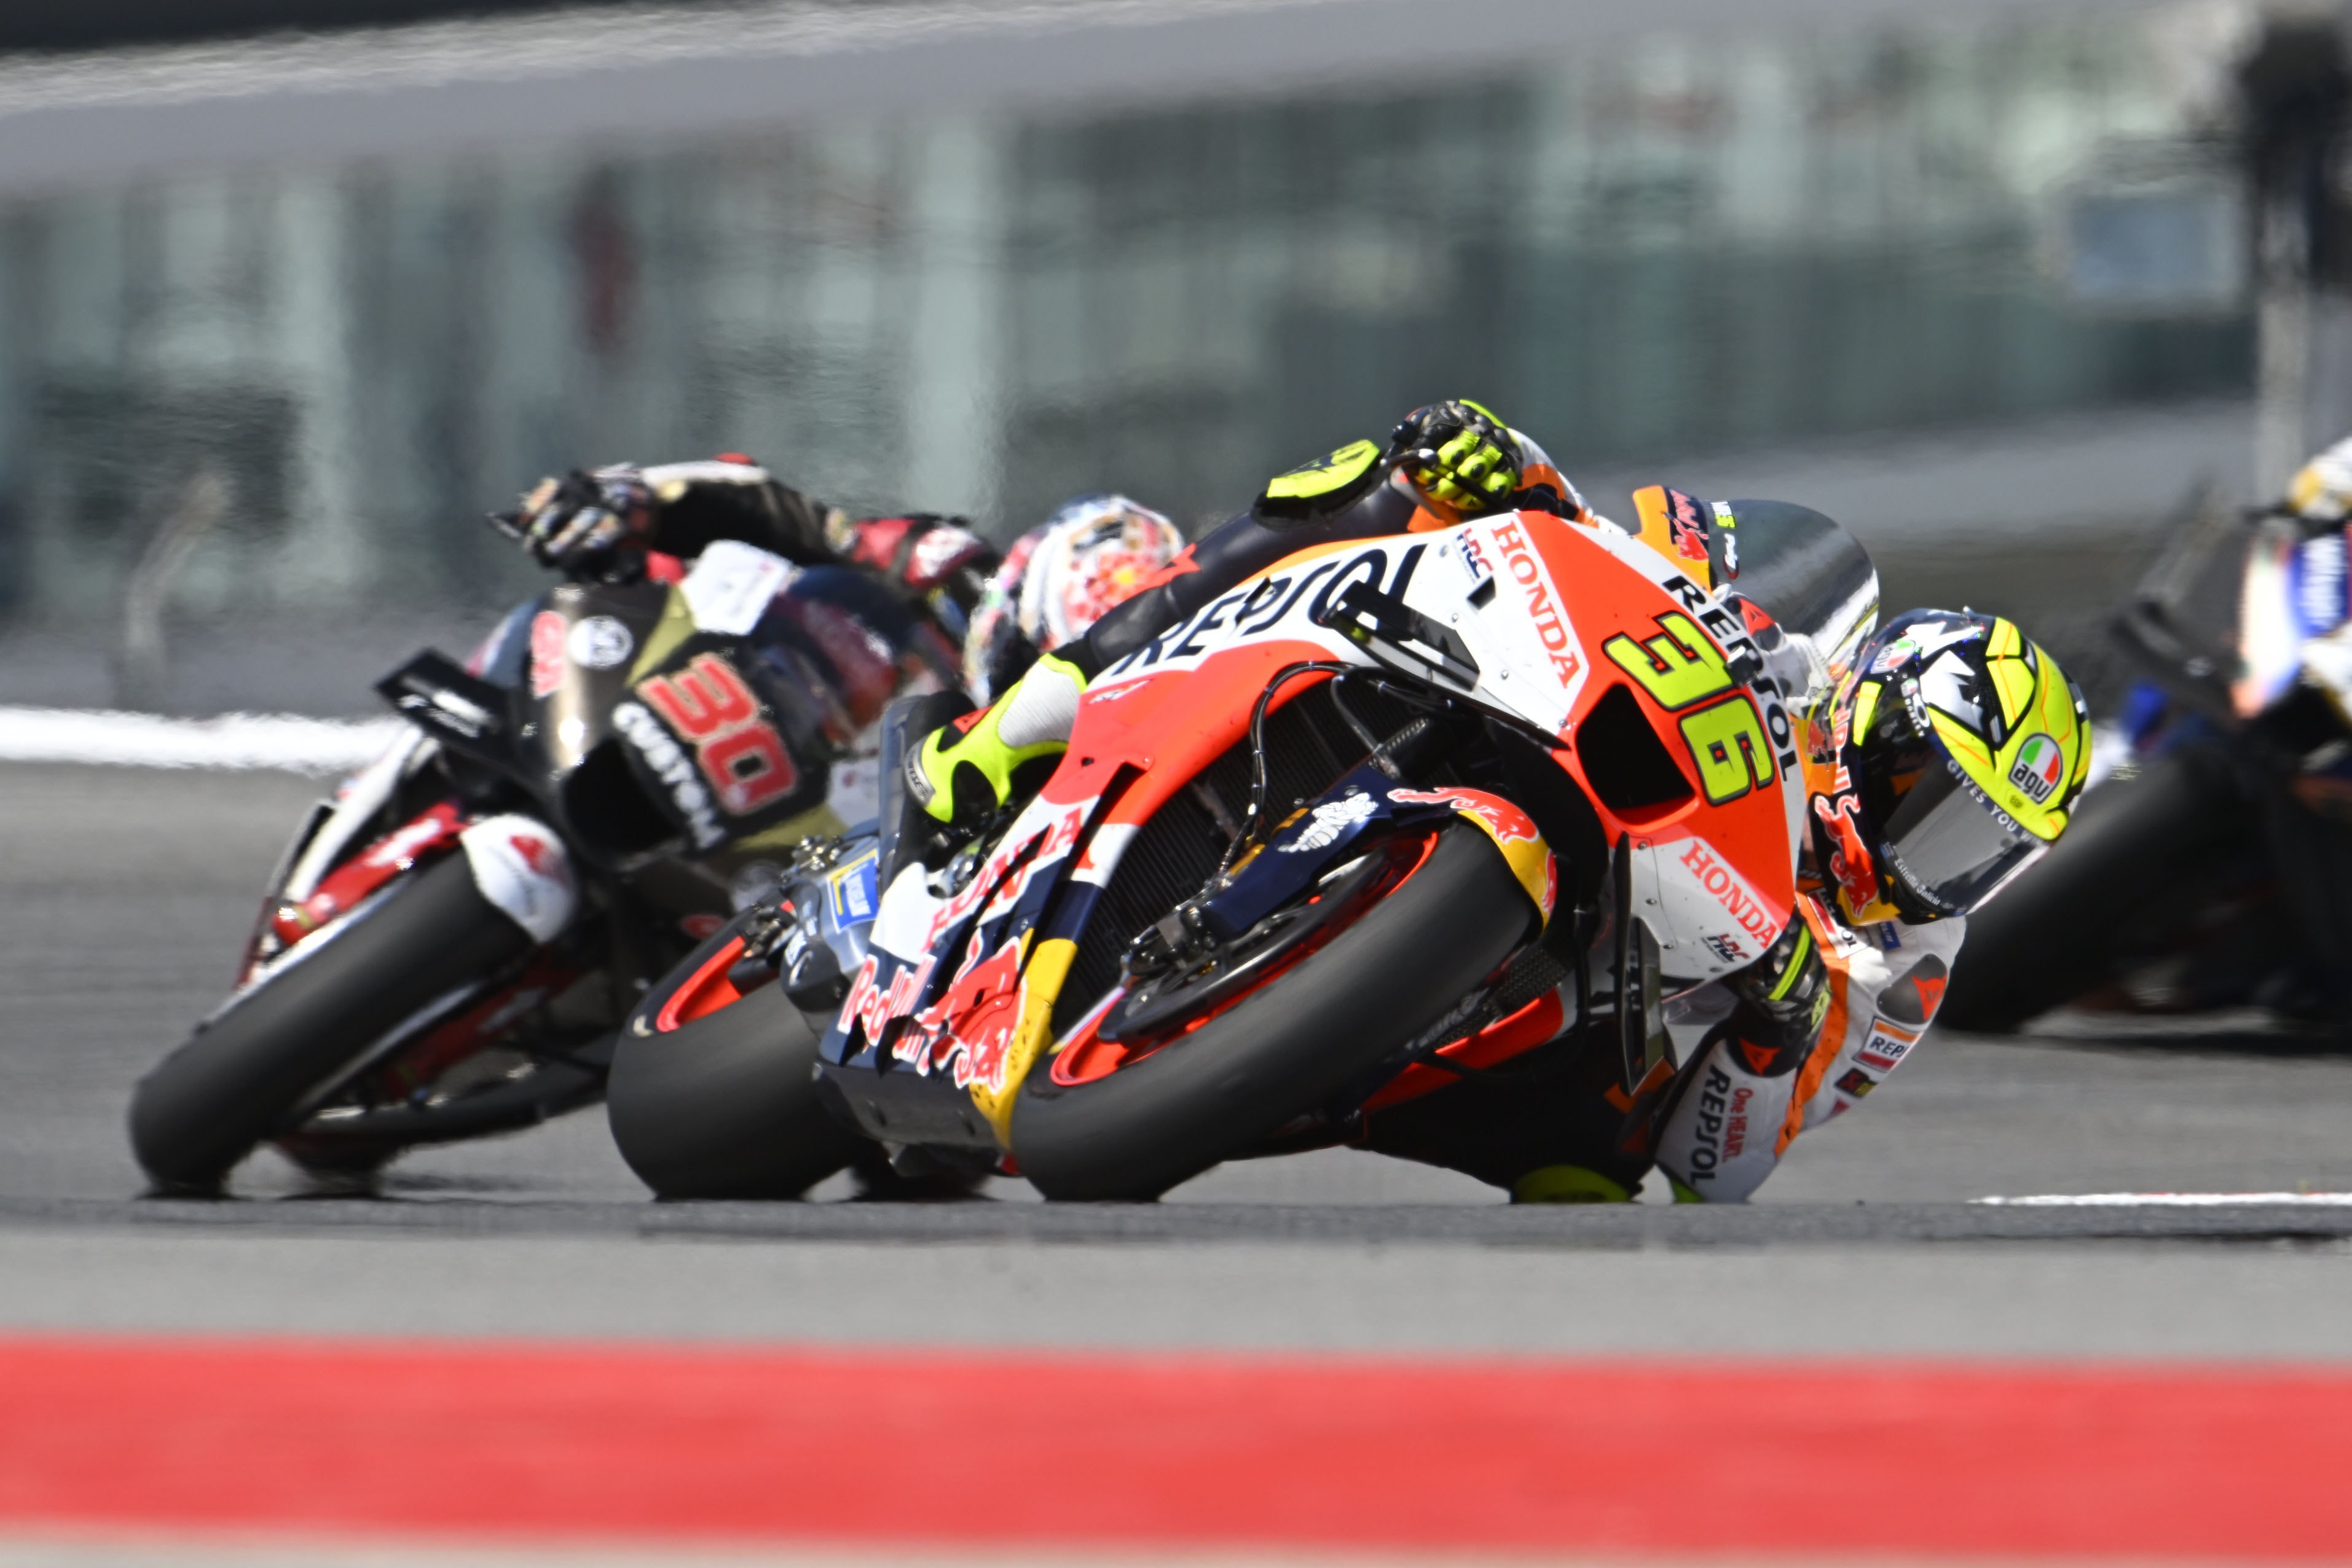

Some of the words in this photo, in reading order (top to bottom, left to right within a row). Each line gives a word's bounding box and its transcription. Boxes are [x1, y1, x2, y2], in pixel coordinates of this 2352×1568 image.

[1490, 520, 1580, 689] HONDA
[635, 651, 797, 817] 30
[1601, 610, 1775, 807] 36
[1661, 575, 1797, 782] REPSOL
[1947, 759, 1987, 804] GIVES
[1990, 805, 2019, 832] YOU
[2013, 763, 2050, 798] agv
[1680, 839, 1777, 950] HONDA
[1729, 1087, 1755, 1114] One
[1869, 1035, 1909, 1058] REP
[1691, 1064, 1731, 1185] REPSOL
